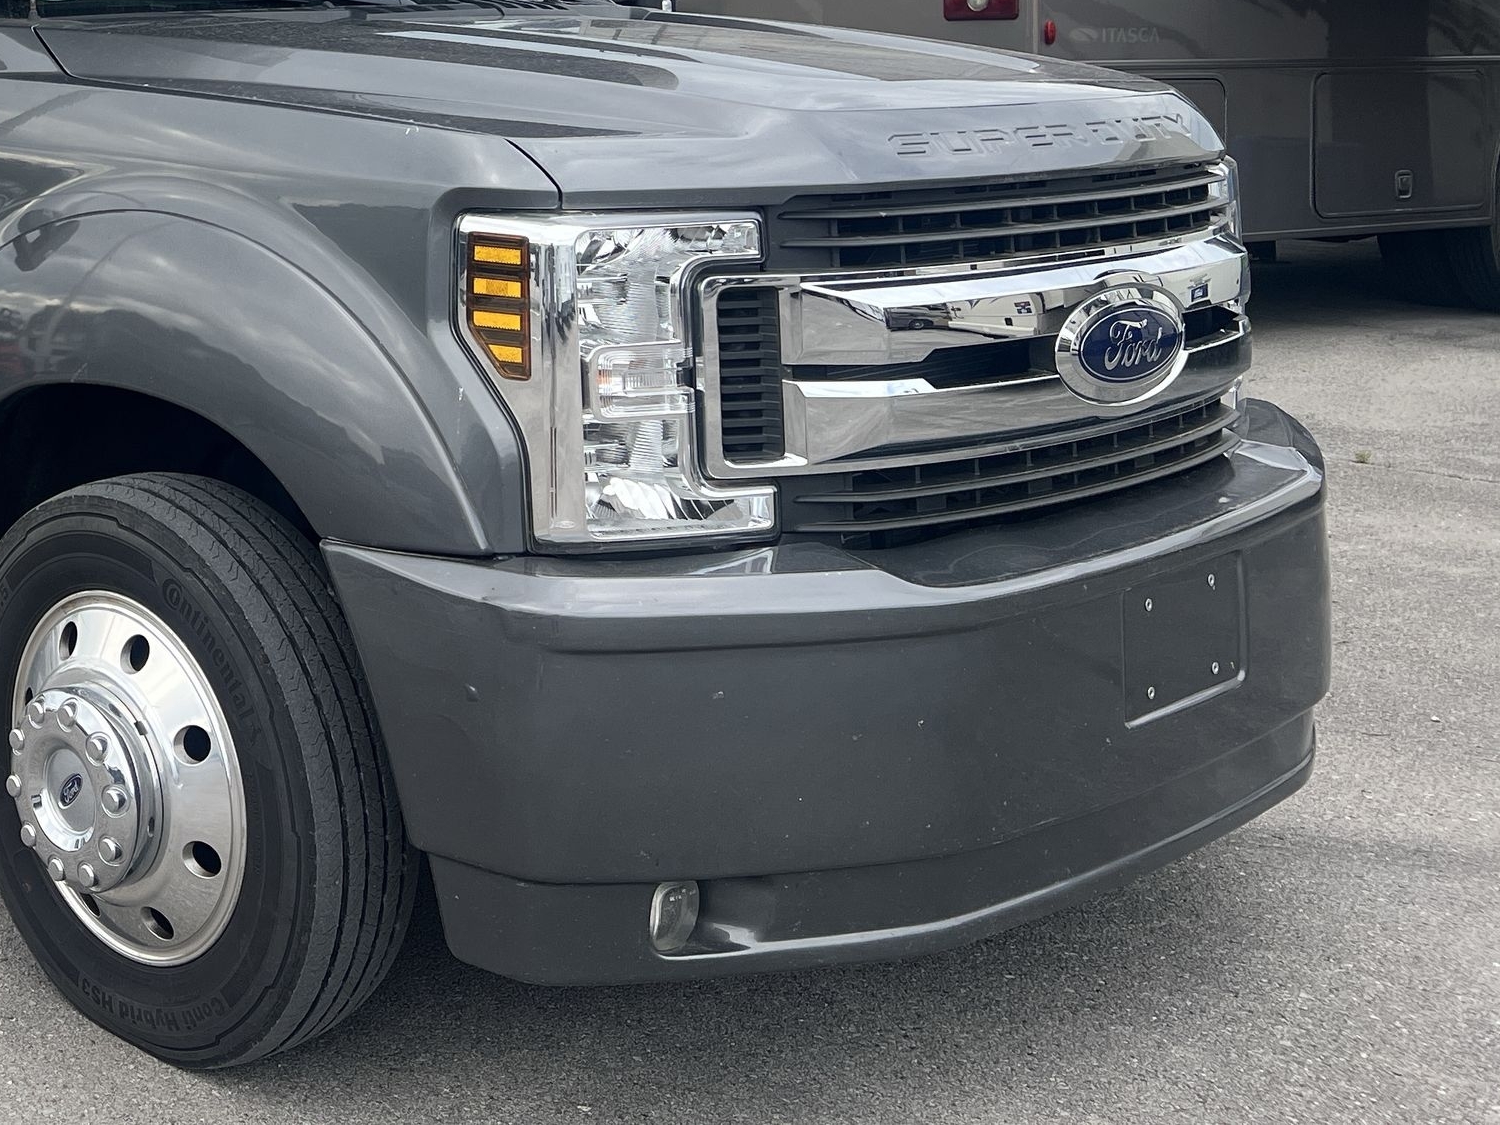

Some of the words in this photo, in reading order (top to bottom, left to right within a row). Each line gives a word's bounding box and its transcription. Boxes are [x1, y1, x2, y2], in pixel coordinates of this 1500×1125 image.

[1101, 26, 1160, 44] ITASCA
[887, 124, 1089, 160] SUPER
[1104, 318, 1163, 371] Ford
[161, 578, 255, 722] Continental
[81, 978, 114, 1014] HS3
[181, 996, 225, 1030] Conti
[118, 1000, 181, 1032] Hybrid
